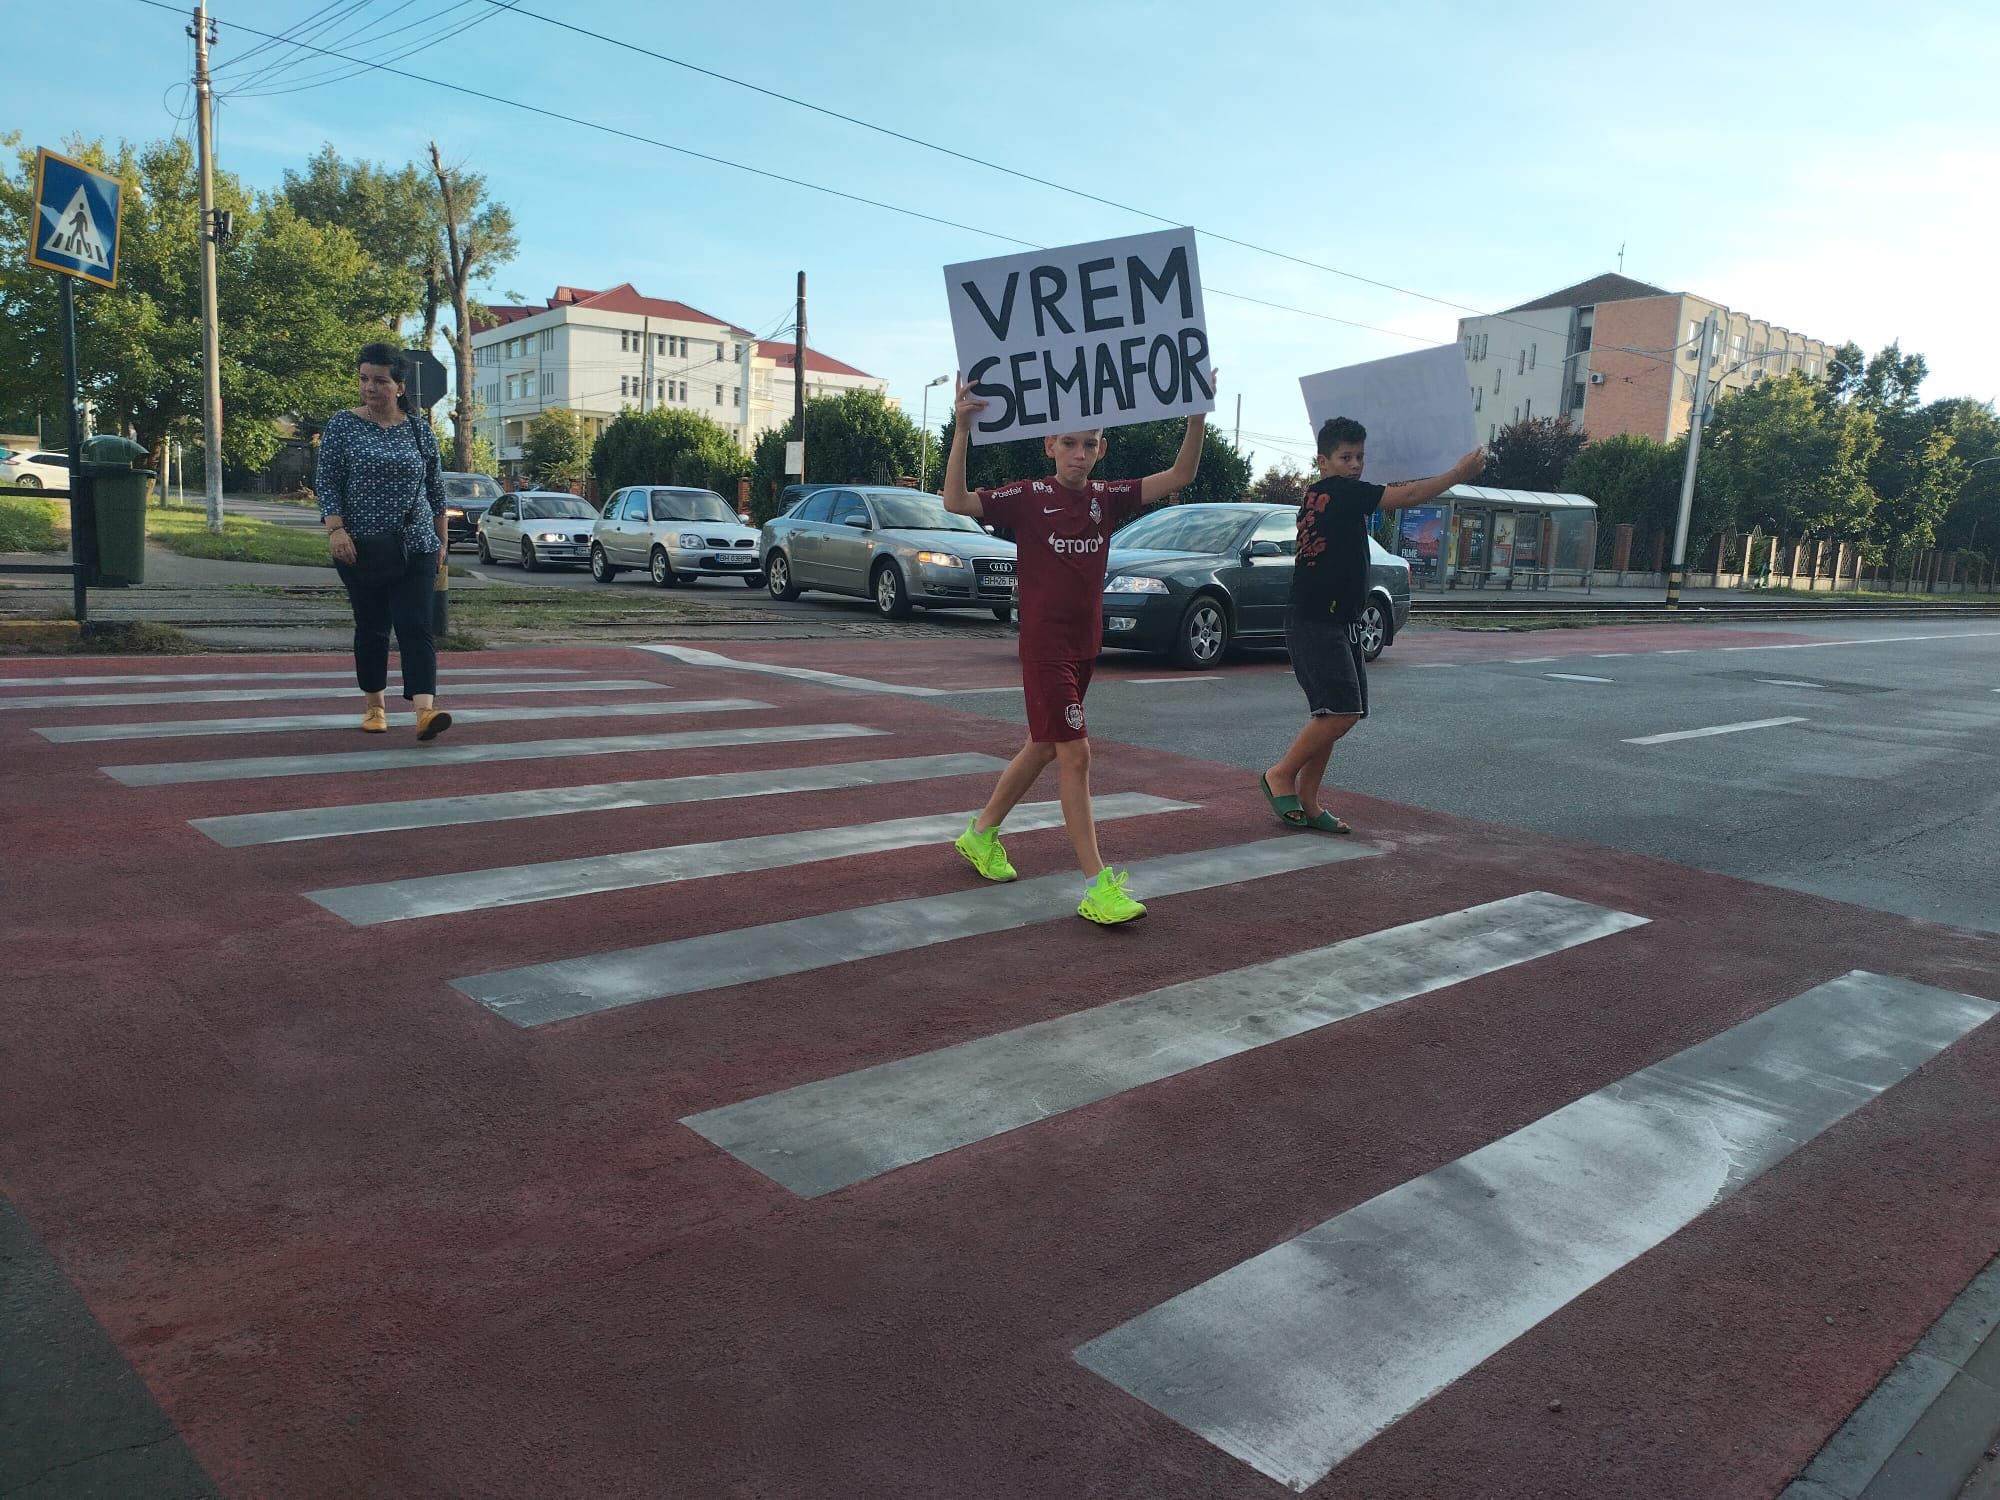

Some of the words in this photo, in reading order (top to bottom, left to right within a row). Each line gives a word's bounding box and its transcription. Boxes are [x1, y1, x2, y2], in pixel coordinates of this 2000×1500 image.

[961, 246, 1194, 342] VREM
[967, 327, 1214, 433] SEMAFOR
[984, 575, 996, 585] BH
